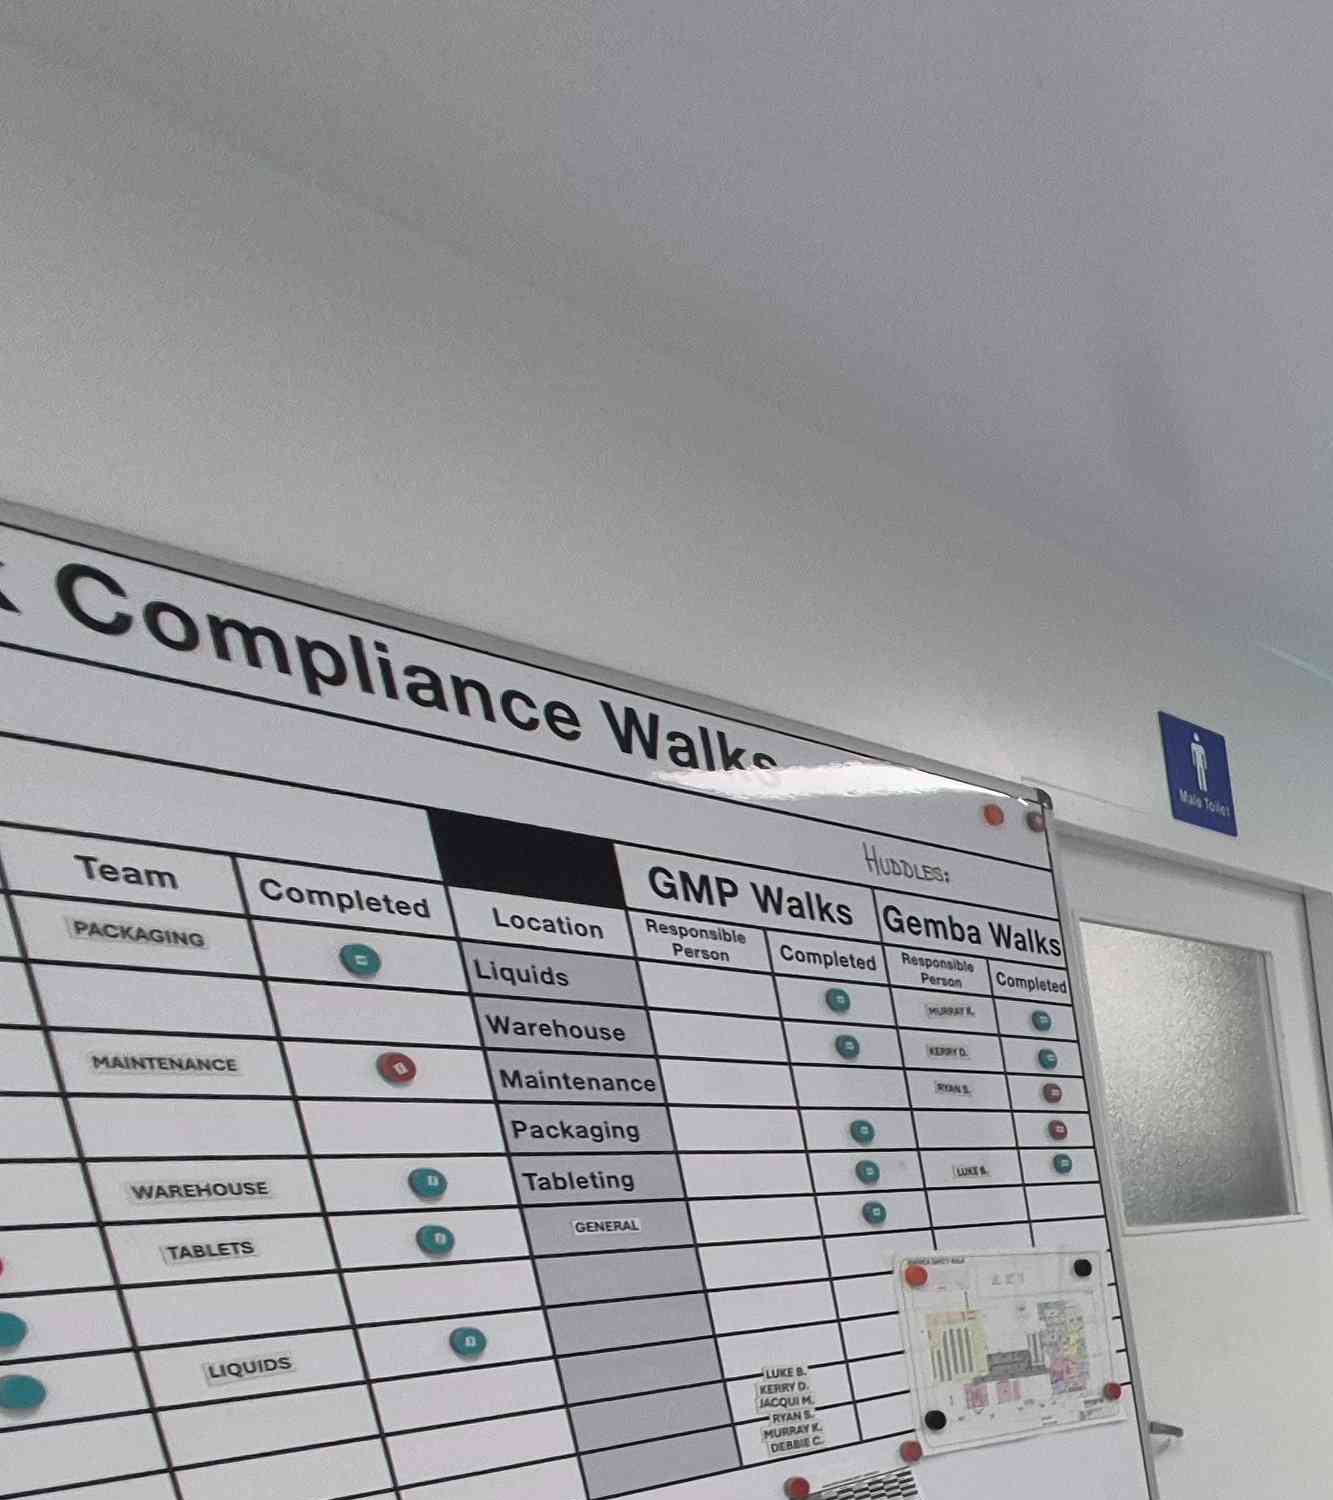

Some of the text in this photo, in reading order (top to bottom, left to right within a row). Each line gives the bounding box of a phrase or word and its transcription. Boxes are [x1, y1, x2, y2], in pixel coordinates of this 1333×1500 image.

[55, 562, 582, 741] Compliance
[74, 855, 180, 890] Team
[259, 878, 431, 919] Completed
[648, 866, 853, 925] GMP Walks
[74, 919, 206, 948] PACKAGING
[493, 907, 604, 940] Location
[647, 919, 746, 945] Responsible
[883, 905, 1062, 957] Gemba Walks
[672, 943, 730, 963] Person
[780, 944, 877, 972] Completed
[901, 952, 974, 973] Responsible
[474, 959, 569, 987] Liquids
[921, 972, 962, 988] Person
[996, 972, 1067, 994] Completed
[485, 1014, 626, 1042] Warehouse
[91, 1054, 238, 1074] MAINTENANCE
[500, 1069, 656, 1092] Maintenance
[511, 1120, 640, 1143] Packaging
[131, 1181, 269, 1200] WAREHOUSE
[522, 1172, 635, 1192] Tableting
[575, 1220, 639, 1233] GENERAL
[167, 1240, 255, 1261] TABLETS
[208, 1356, 293, 1379] LIQUIDS
[765, 1368, 793, 1379] LUKE
[760, 1383, 795, 1395] KERRY
[760, 1396, 801, 1409] JACQUI
[772, 1411, 801, 1424] RYAN
[763, 1424, 811, 1440] MURRAY
[771, 1438, 811, 1453] DEBBIE
